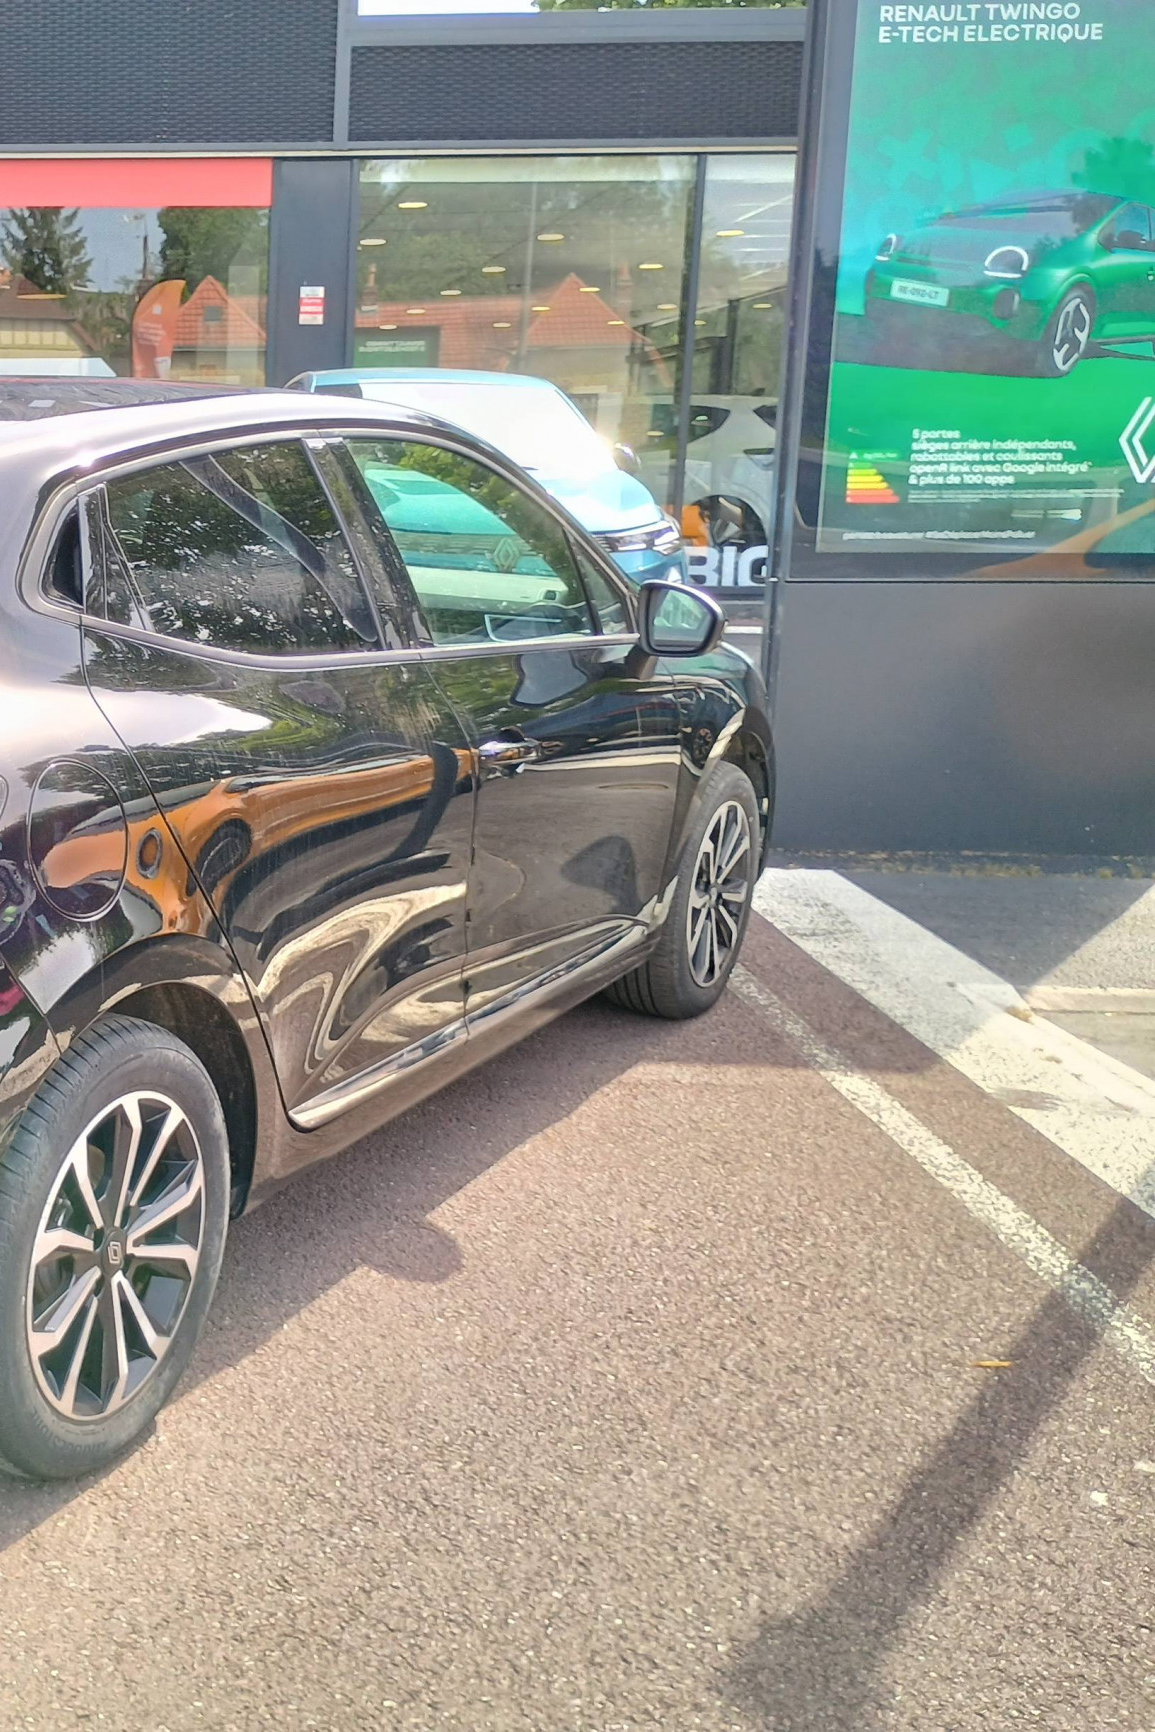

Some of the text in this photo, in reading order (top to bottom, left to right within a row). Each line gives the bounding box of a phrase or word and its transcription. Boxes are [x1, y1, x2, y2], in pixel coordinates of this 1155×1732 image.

[879, 2, 1081, 23] RENAULT TWINGO
[878, 22, 1104, 44] E-TECH ELECTRIQUE
[920, 429, 962, 441] portes
[911, 439, 950, 453] sièges
[950, 438, 991, 451] arrière
[910, 451, 981, 463] rabattables
[981, 451, 995, 463] et
[995, 449, 1064, 462] coulissants
[949, 463, 972, 474] link
[972, 464, 1002, 474] avec
[1002, 462, 1045, 475] Google
[918, 475, 944, 487] plus
[943, 475, 962, 485] de
[962, 474, 984, 485] 100
[983, 475, 1016, 487] apps
